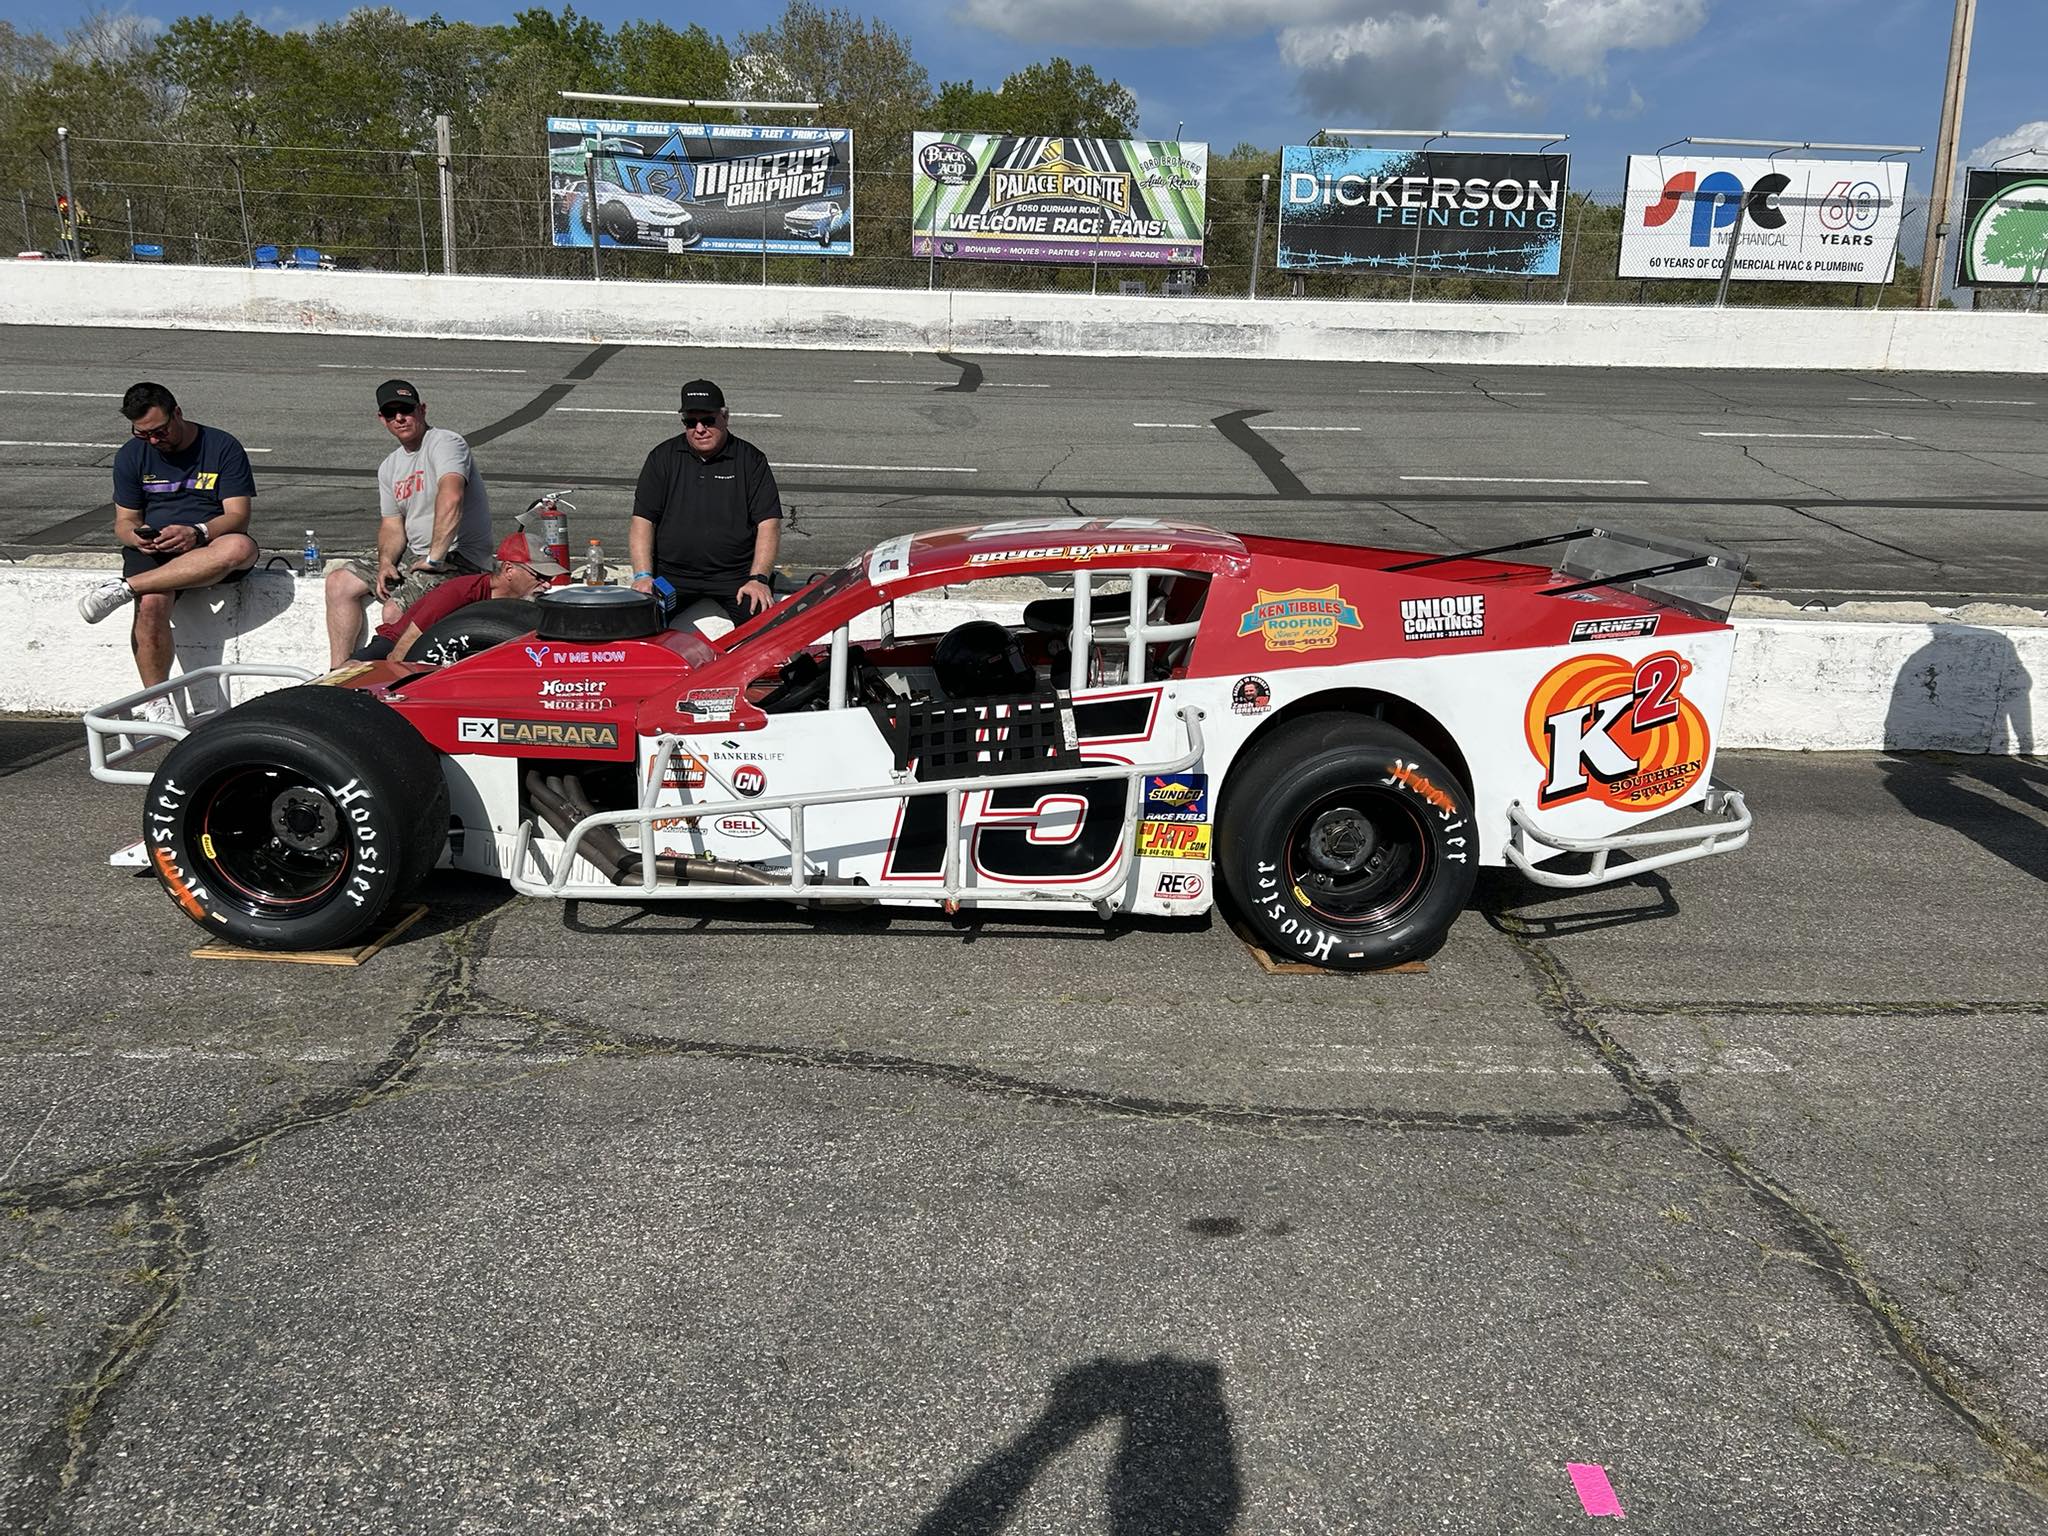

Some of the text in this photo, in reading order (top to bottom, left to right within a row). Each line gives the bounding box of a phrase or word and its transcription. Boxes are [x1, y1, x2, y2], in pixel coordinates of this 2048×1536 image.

[597, 123, 628, 134] WRAPS
[636, 124, 670, 135] DECALS
[680, 126, 705, 136] SIGNS
[712, 127, 753, 138] BANNERS
[760, 129, 785, 139] FLEET
[924, 145, 966, 165] BLACK
[694, 146, 831, 197] MINCEY'S
[938, 162, 967, 176] ACID
[727, 171, 826, 207] GRAPHICS
[995, 173, 1124, 206] PALACE POINTE
[1140, 173, 1200, 191] Auto Repair
[1289, 172, 1560, 211] DICKERSON
[1016, 203, 1039, 213] 5050
[1040, 204, 1078, 214] DURHAM
[1819, 181, 1881, 230] 60
[950, 212, 1169, 237] WELCOME RACE FANS!
[1377, 207, 1557, 229] FENCING
[1820, 233, 1874, 246] YEARS
[964, 245, 1002, 254] BOWLING
[1009, 247, 1040, 255] MOVIES
[1129, 251, 1161, 259] ARCADE
[1649, 256, 1864, 272] 60 YEARS OF COMERCIAL HVAC & PLUMBING
[1259, 601, 1342, 619] KEN TIBBLES
[1400, 595, 1485, 620] UNIQUE
[1268, 617, 1333, 630] ROOFING
[1404, 614, 1484, 634] COATINGS
[1574, 617, 1657, 636] EARNEST
[553, 651, 626, 664] IV ME NOW
[538, 678, 607, 695] Hoosier
[462, 721, 617, 746] FX CAPRARA
[663, 769, 704, 781] DRILLING
[735, 772, 763, 792] CN
[1609, 759, 1702, 794] SOUTHERN
[1150, 790, 1203, 800] SUNOCO
[1630, 777, 1686, 802] STYLE
[722, 820, 760, 830] BELL
[1146, 813, 1207, 821] RACE FUELS
[326, 778, 385, 907] Hoosier
[1146, 823, 1207, 851] HTP .COM
[1252, 860, 1343, 961] Hoosier
